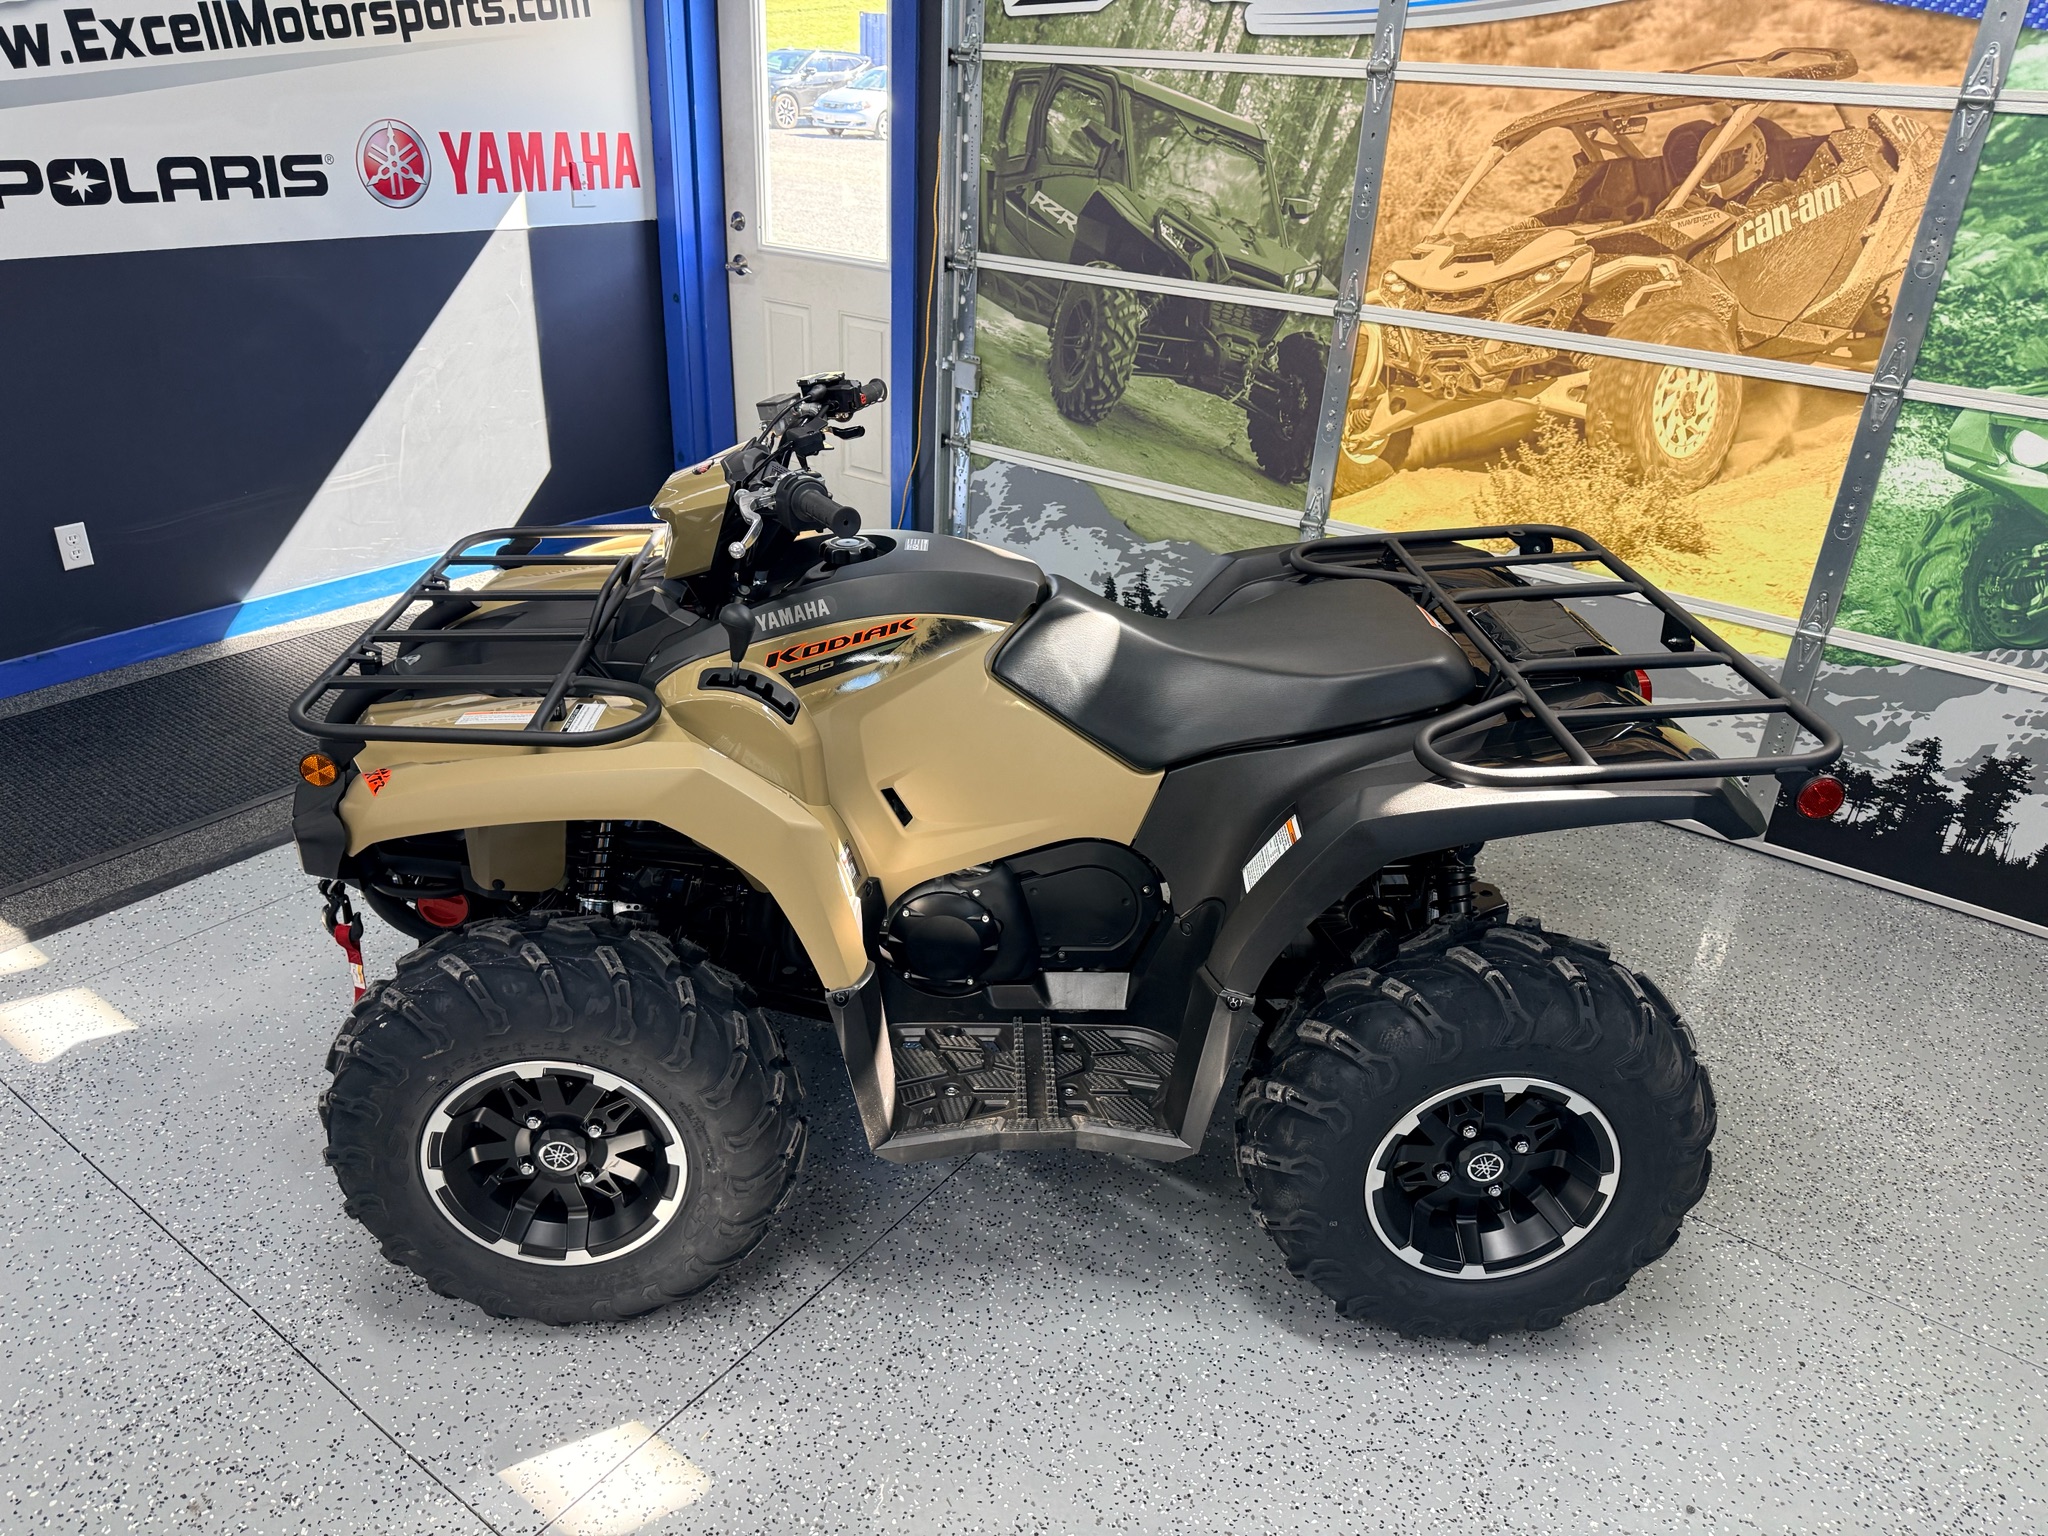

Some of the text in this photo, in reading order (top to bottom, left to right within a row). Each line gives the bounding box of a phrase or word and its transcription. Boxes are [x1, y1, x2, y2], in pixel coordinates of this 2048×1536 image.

[438, 131, 641, 195] YAMAHA
[1029, 190, 1078, 234] RZR
[755, 598, 831, 632] YAMAHA
[765, 617, 919, 670] KODIAK
[789, 660, 836, 679] 450
